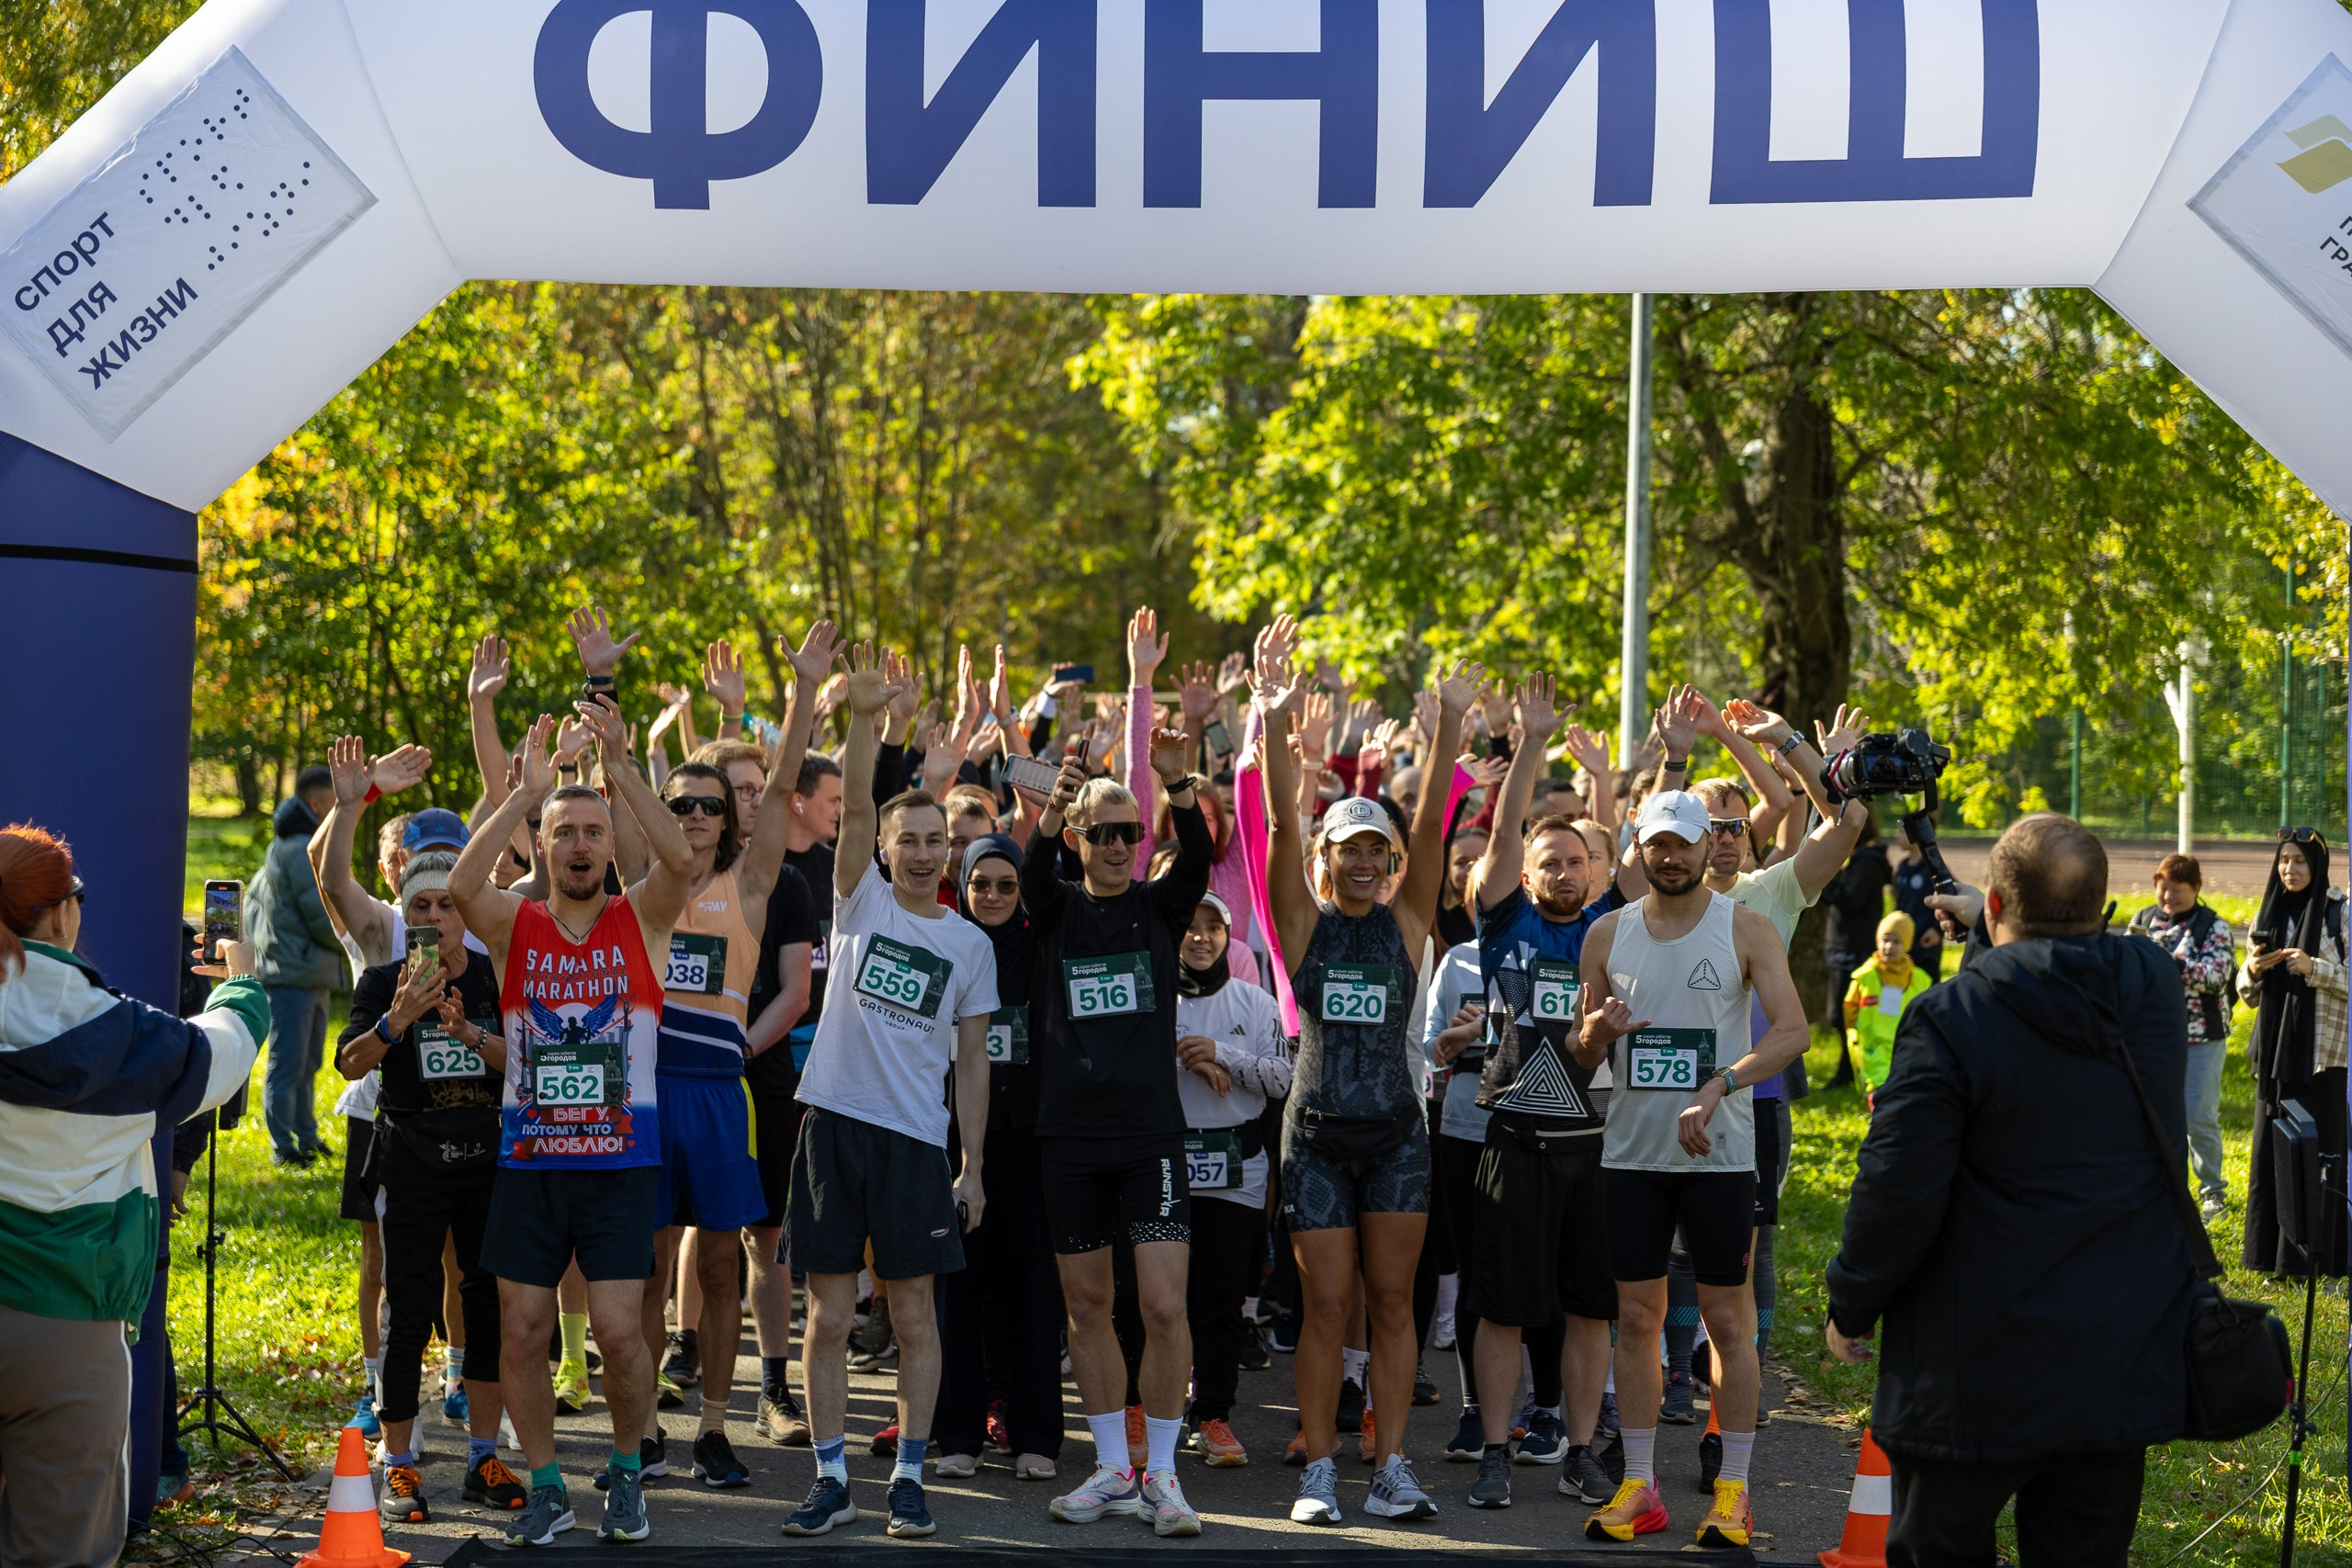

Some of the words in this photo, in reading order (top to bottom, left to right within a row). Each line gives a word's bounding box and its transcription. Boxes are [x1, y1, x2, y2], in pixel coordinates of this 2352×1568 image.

[534, 0, 2040, 210] ФИНИШ
[526, 945, 625, 975] SAMARA
[882, 948, 910, 962] городов
[1079, 966, 1107, 975] городов
[1539, 968, 1545, 976] 5
[523, 976, 628, 999] MARATHON
[865, 965, 921, 1002] 559
[1080, 985, 1128, 1011] 516
[1327, 993, 1382, 1018] 620
[859, 998, 935, 1035] GASTRONAUT
[426, 1050, 481, 1073] 625
[1636, 1059, 1690, 1084] 578
[542, 1075, 599, 1100] 562
[553, 1106, 609, 1122] БЕГУ,
[522, 1124, 578, 1135] ПОТОМУ
[582, 1124, 611, 1135] ЧТО
[533, 1136, 623, 1153] ЛЮБЛЮ!
